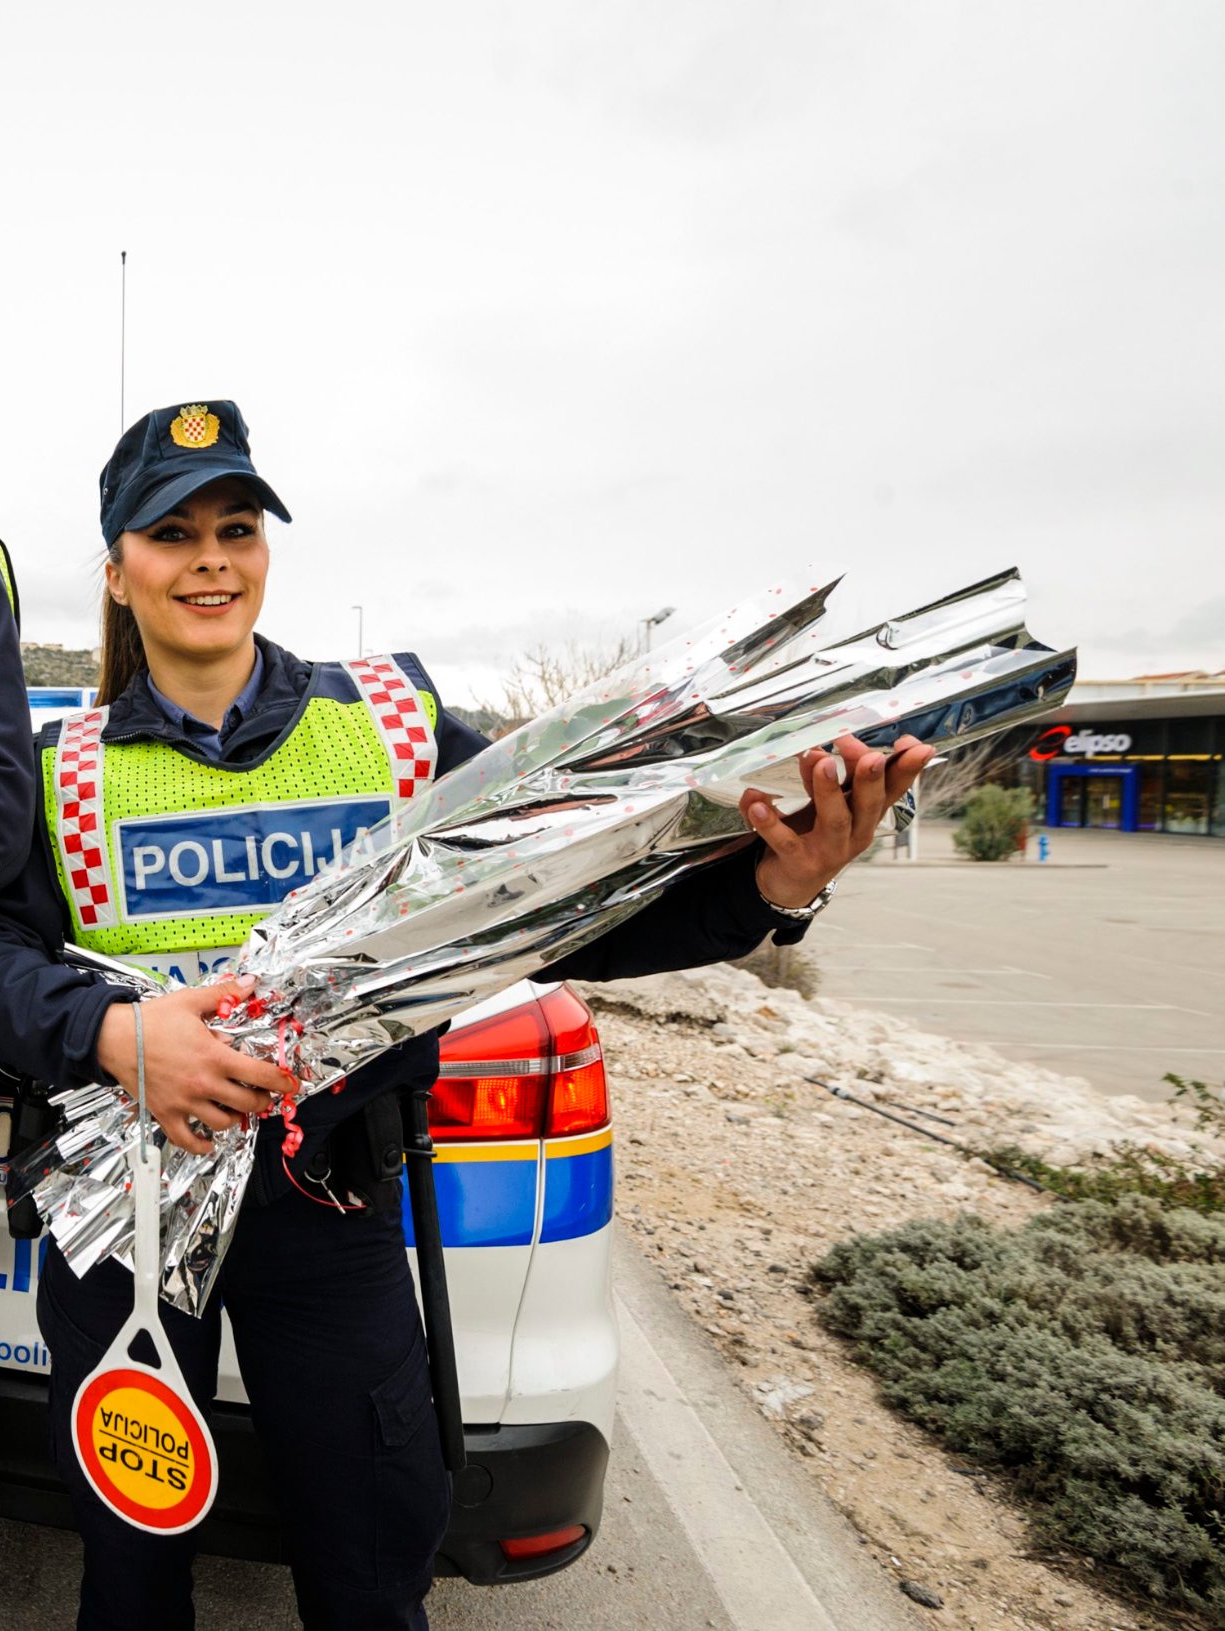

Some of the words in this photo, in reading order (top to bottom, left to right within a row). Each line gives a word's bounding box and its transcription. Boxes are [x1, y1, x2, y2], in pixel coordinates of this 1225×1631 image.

[133, 826, 378, 891] POLICIJA
[101, 1407, 189, 1460] POLICIJA
[99, 1443, 187, 1491] STOP
